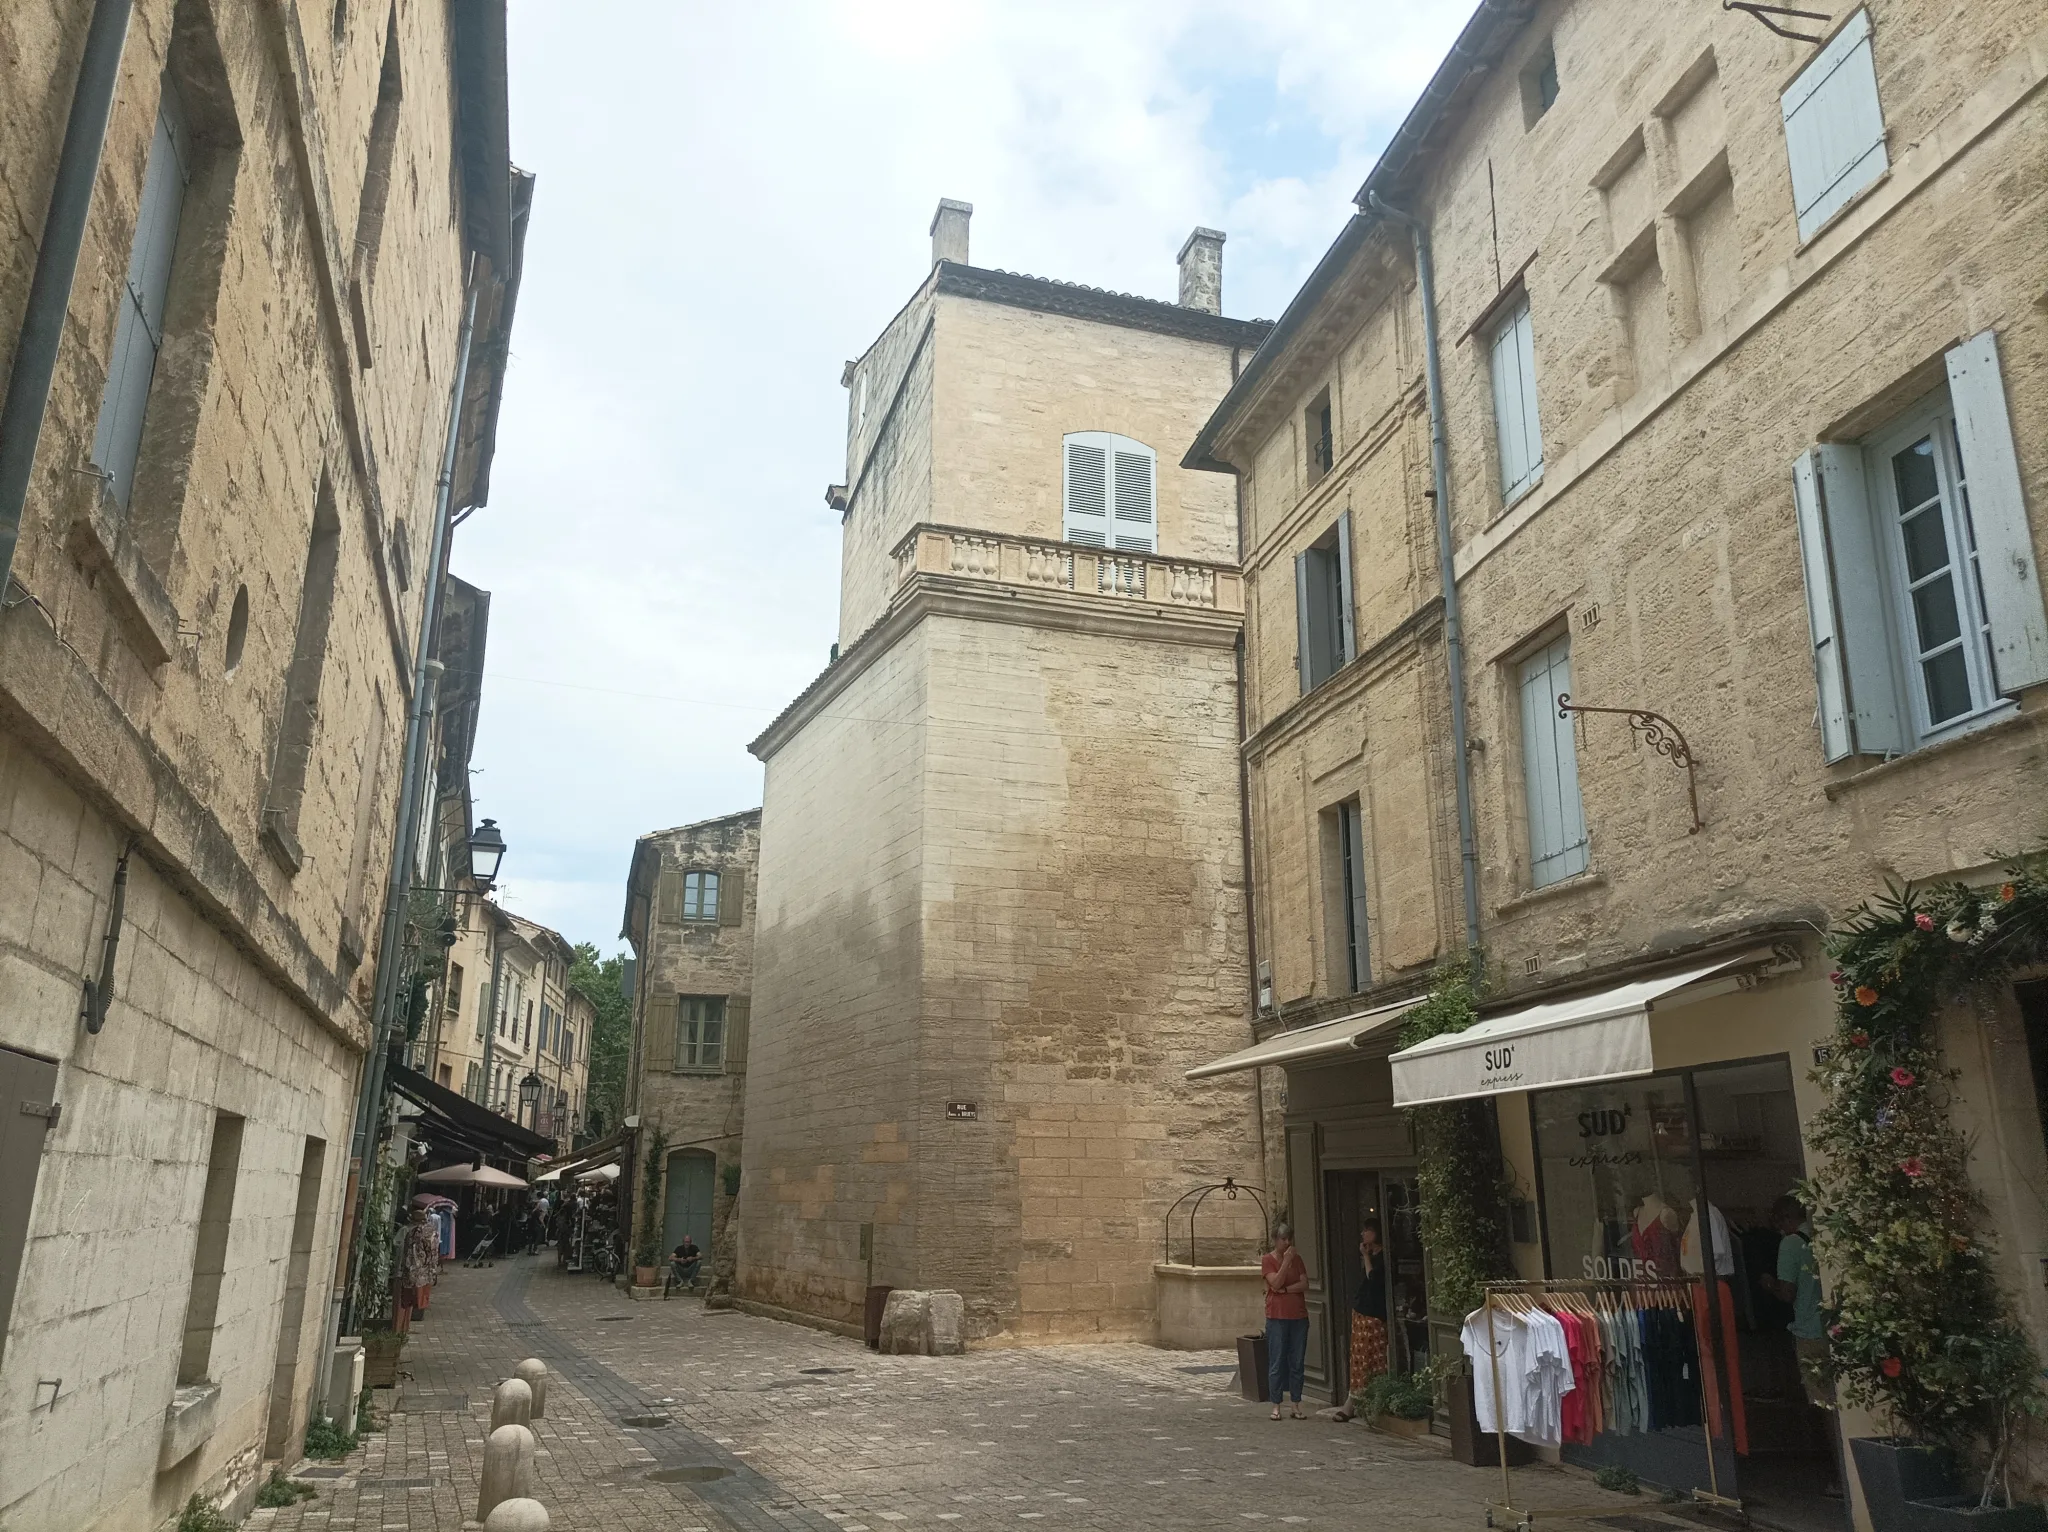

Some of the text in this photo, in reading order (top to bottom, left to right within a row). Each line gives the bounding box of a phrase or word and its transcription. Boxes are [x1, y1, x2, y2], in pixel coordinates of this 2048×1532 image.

[1480, 1072, 1524, 1090] express
[1569, 1151, 1642, 1175] express
[1582, 1255, 1658, 1288] SOLDES
